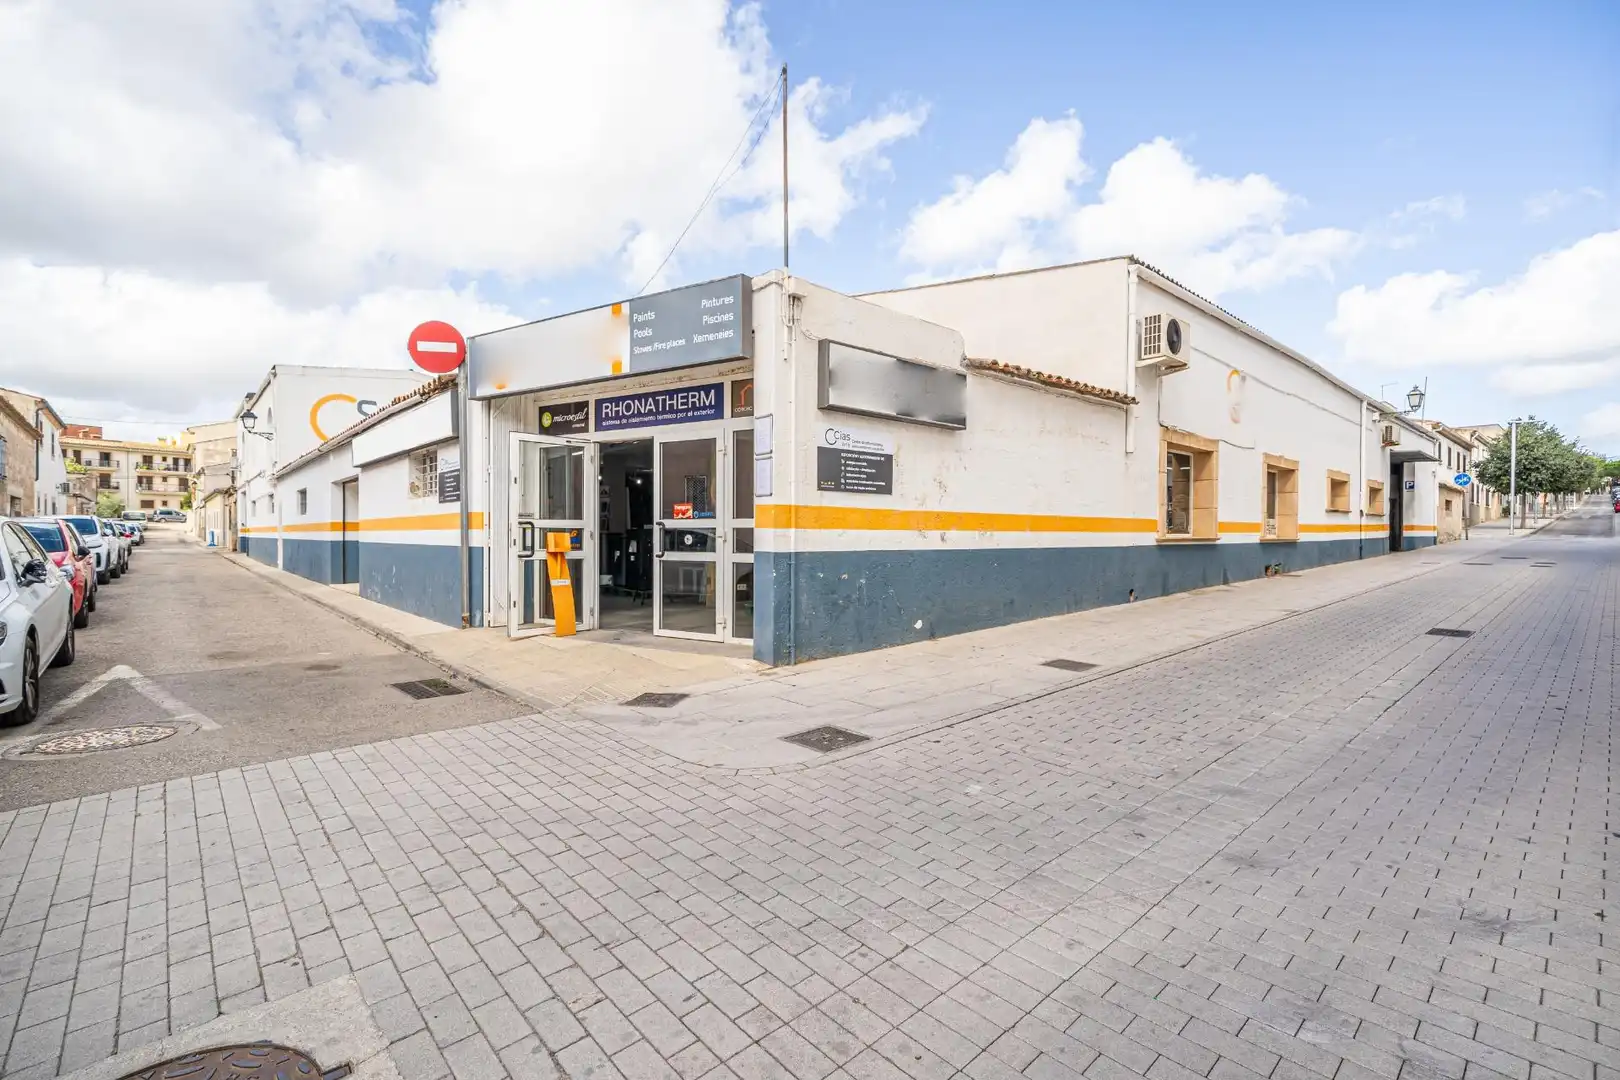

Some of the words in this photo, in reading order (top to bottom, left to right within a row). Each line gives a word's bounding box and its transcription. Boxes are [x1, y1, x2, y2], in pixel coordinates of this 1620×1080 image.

[701, 295, 734, 309] Pintures
[633, 310, 656, 323] Paints
[702, 312, 734, 326] Piscines
[633, 327, 653, 339] Pools
[693, 328, 734, 344] Xemeneies
[633, 344, 652, 355] Stoves
[602, 389, 715, 418] RHONATHERM
[693, 408, 716, 416] exterior
